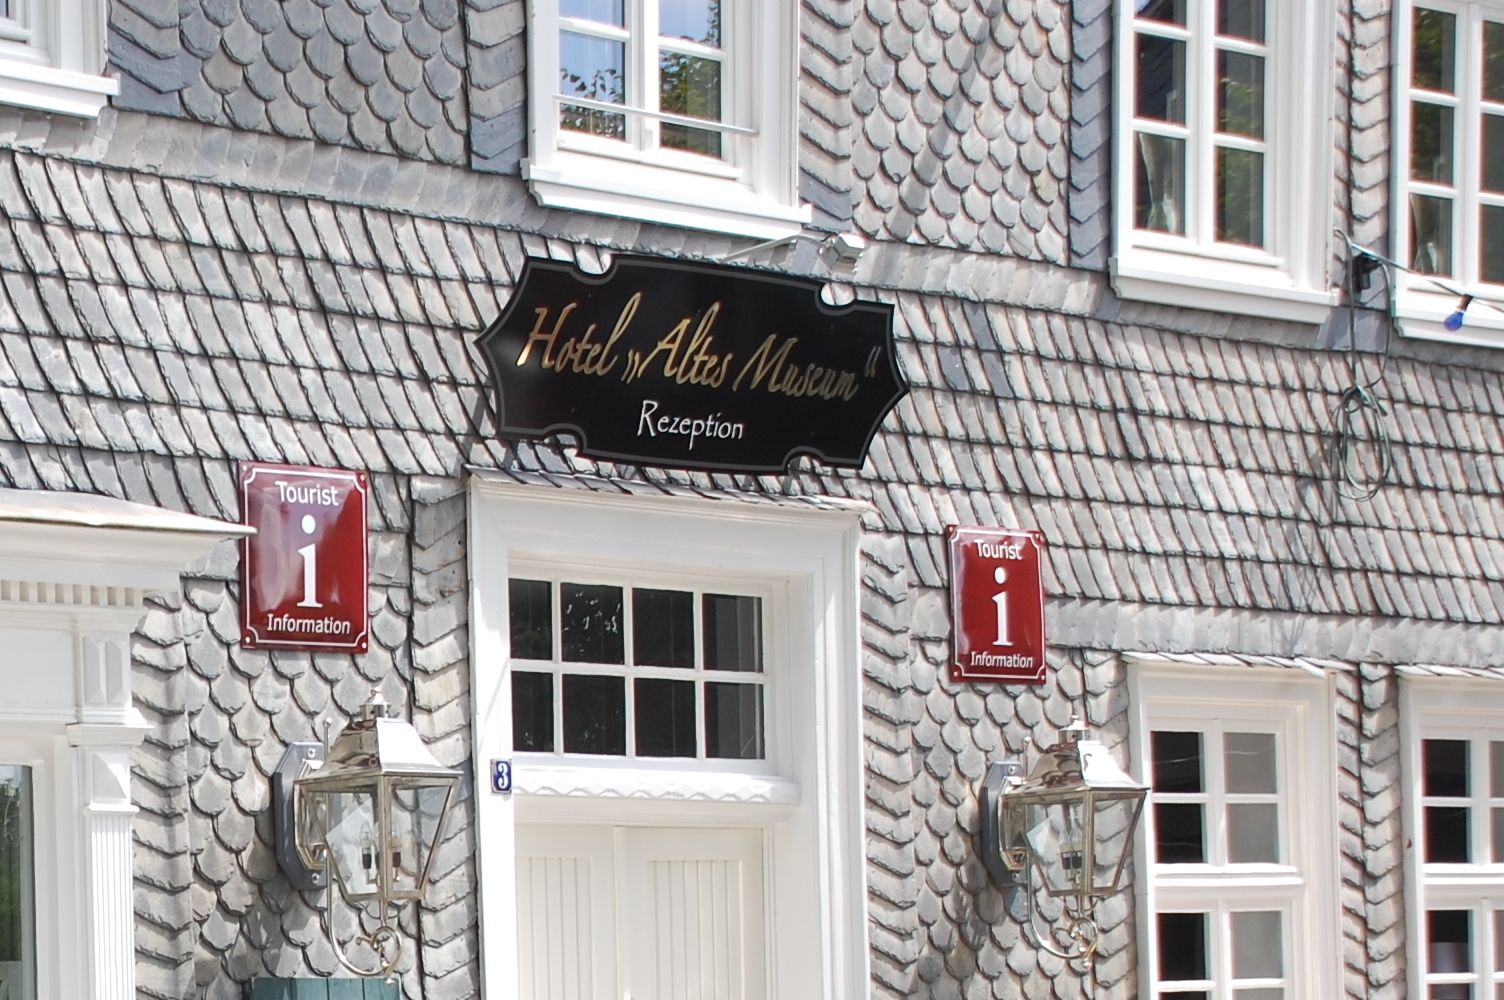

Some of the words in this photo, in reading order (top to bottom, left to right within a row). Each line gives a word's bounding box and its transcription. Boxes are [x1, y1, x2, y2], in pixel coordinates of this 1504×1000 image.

[516, 292, 642, 376] Hotel
[637, 401, 744, 449] Rezeption
[274, 481, 339, 506] Tourist
[974, 540, 1023, 560] Tourist
[266, 613, 351, 635] Information
[970, 651, 1034, 669] Information
[497, 762, 509, 789] 3
